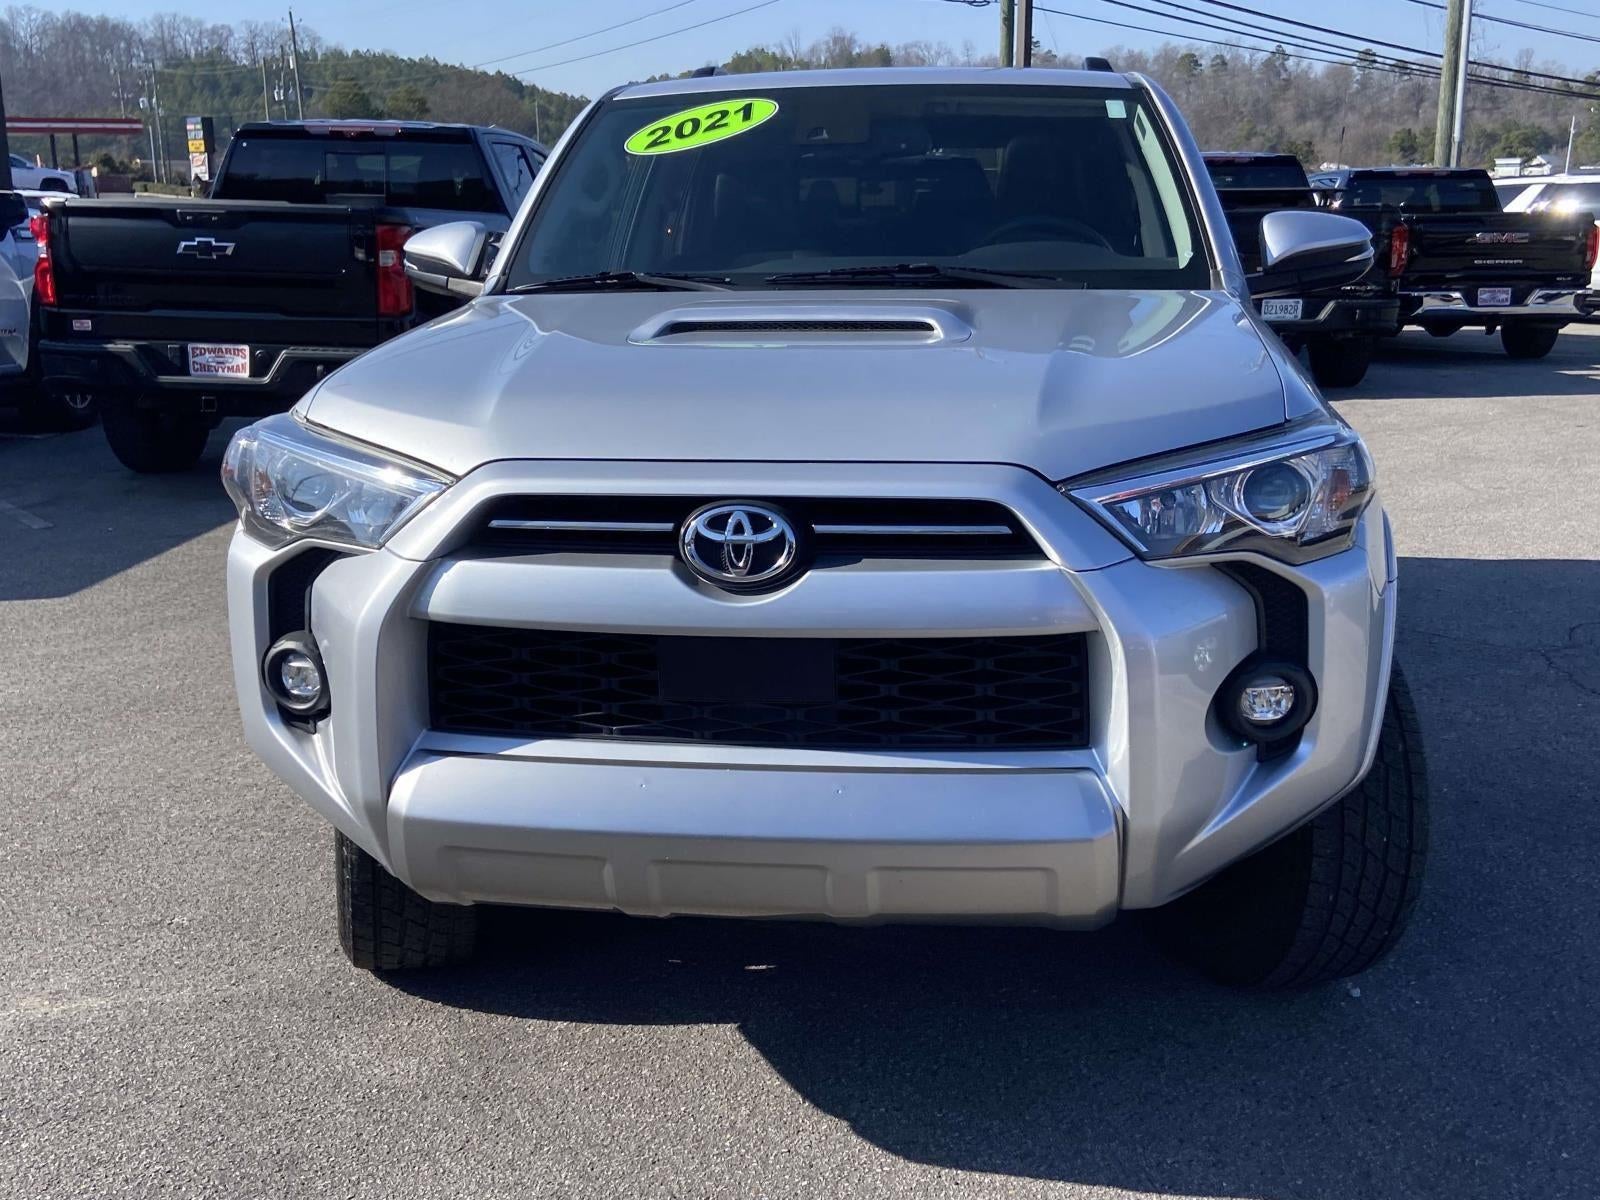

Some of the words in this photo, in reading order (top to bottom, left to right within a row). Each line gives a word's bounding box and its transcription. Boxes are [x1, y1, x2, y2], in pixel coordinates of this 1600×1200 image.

[643, 101, 755, 151] 2021
[1475, 232, 1530, 244] GMC
[190, 346, 247, 360] EDWARDS
[191, 360, 247, 374] CHEVYMAN
